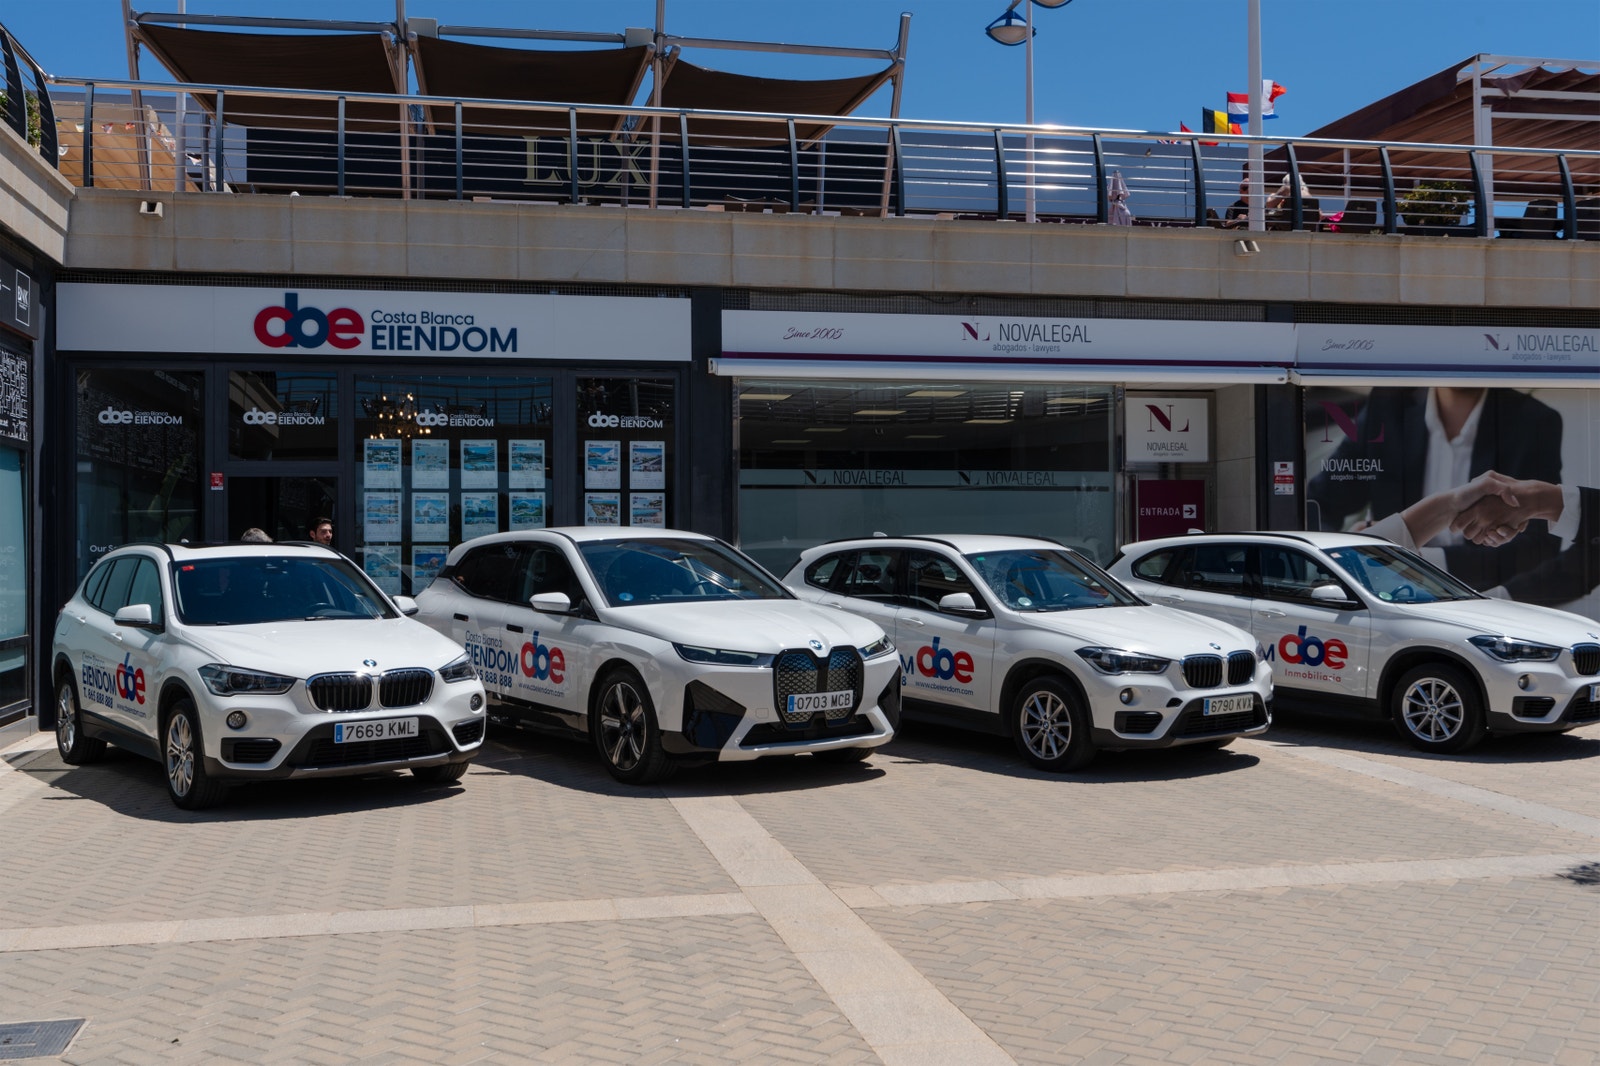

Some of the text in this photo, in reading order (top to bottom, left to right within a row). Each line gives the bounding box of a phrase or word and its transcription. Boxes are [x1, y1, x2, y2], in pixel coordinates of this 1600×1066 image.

[522, 135, 650, 189] LUX
[254, 293, 365, 349] cbe
[371, 310, 474, 326] Costa Blanca
[371, 325, 517, 353] EIENDOM
[783, 327, 844, 340] Since 2005
[999, 323, 1092, 343] NOVALEGAL
[992, 343, 1061, 354] abogados lawyers
[1321, 338, 1375, 351] Since 2005
[1517, 334, 1599, 352] NOVALEGAL
[1511, 352, 1571, 362] abogados lawyers
[134, 416, 183, 425] EIENDOM
[278, 416, 325, 425] EIENDOM
[449, 418, 494, 427] EIENDOM
[620, 420, 663, 428] EIENDOM
[1145, 404, 1190, 432] NL
[1147, 442, 1189, 451] NOVALEGAL
[1320, 458, 1384, 472] NOVALEGAL
[833, 470, 908, 485] NOVALEGAL
[986, 471, 1058, 486] NOVALEGAL
[1140, 507, 1181, 516] ENTRADA
[89, 544, 107, 552] Our
[1278, 625, 1348, 670] cbe
[465, 630, 566, 684] EIENDOM cbe
[916, 636, 974, 684] cbe
[82, 663, 117, 696] EIENDOM
[116, 652, 146, 705] cbe
[485, 671, 498, 684] 888
[499, 674, 512, 688] 888
[1284, 668, 1342, 683] Inmobiliaria
[797, 693, 851, 710] 0703 MCB
[1211, 696, 1252, 713] 6790 KVX
[346, 721, 415, 740] 7669 KML
